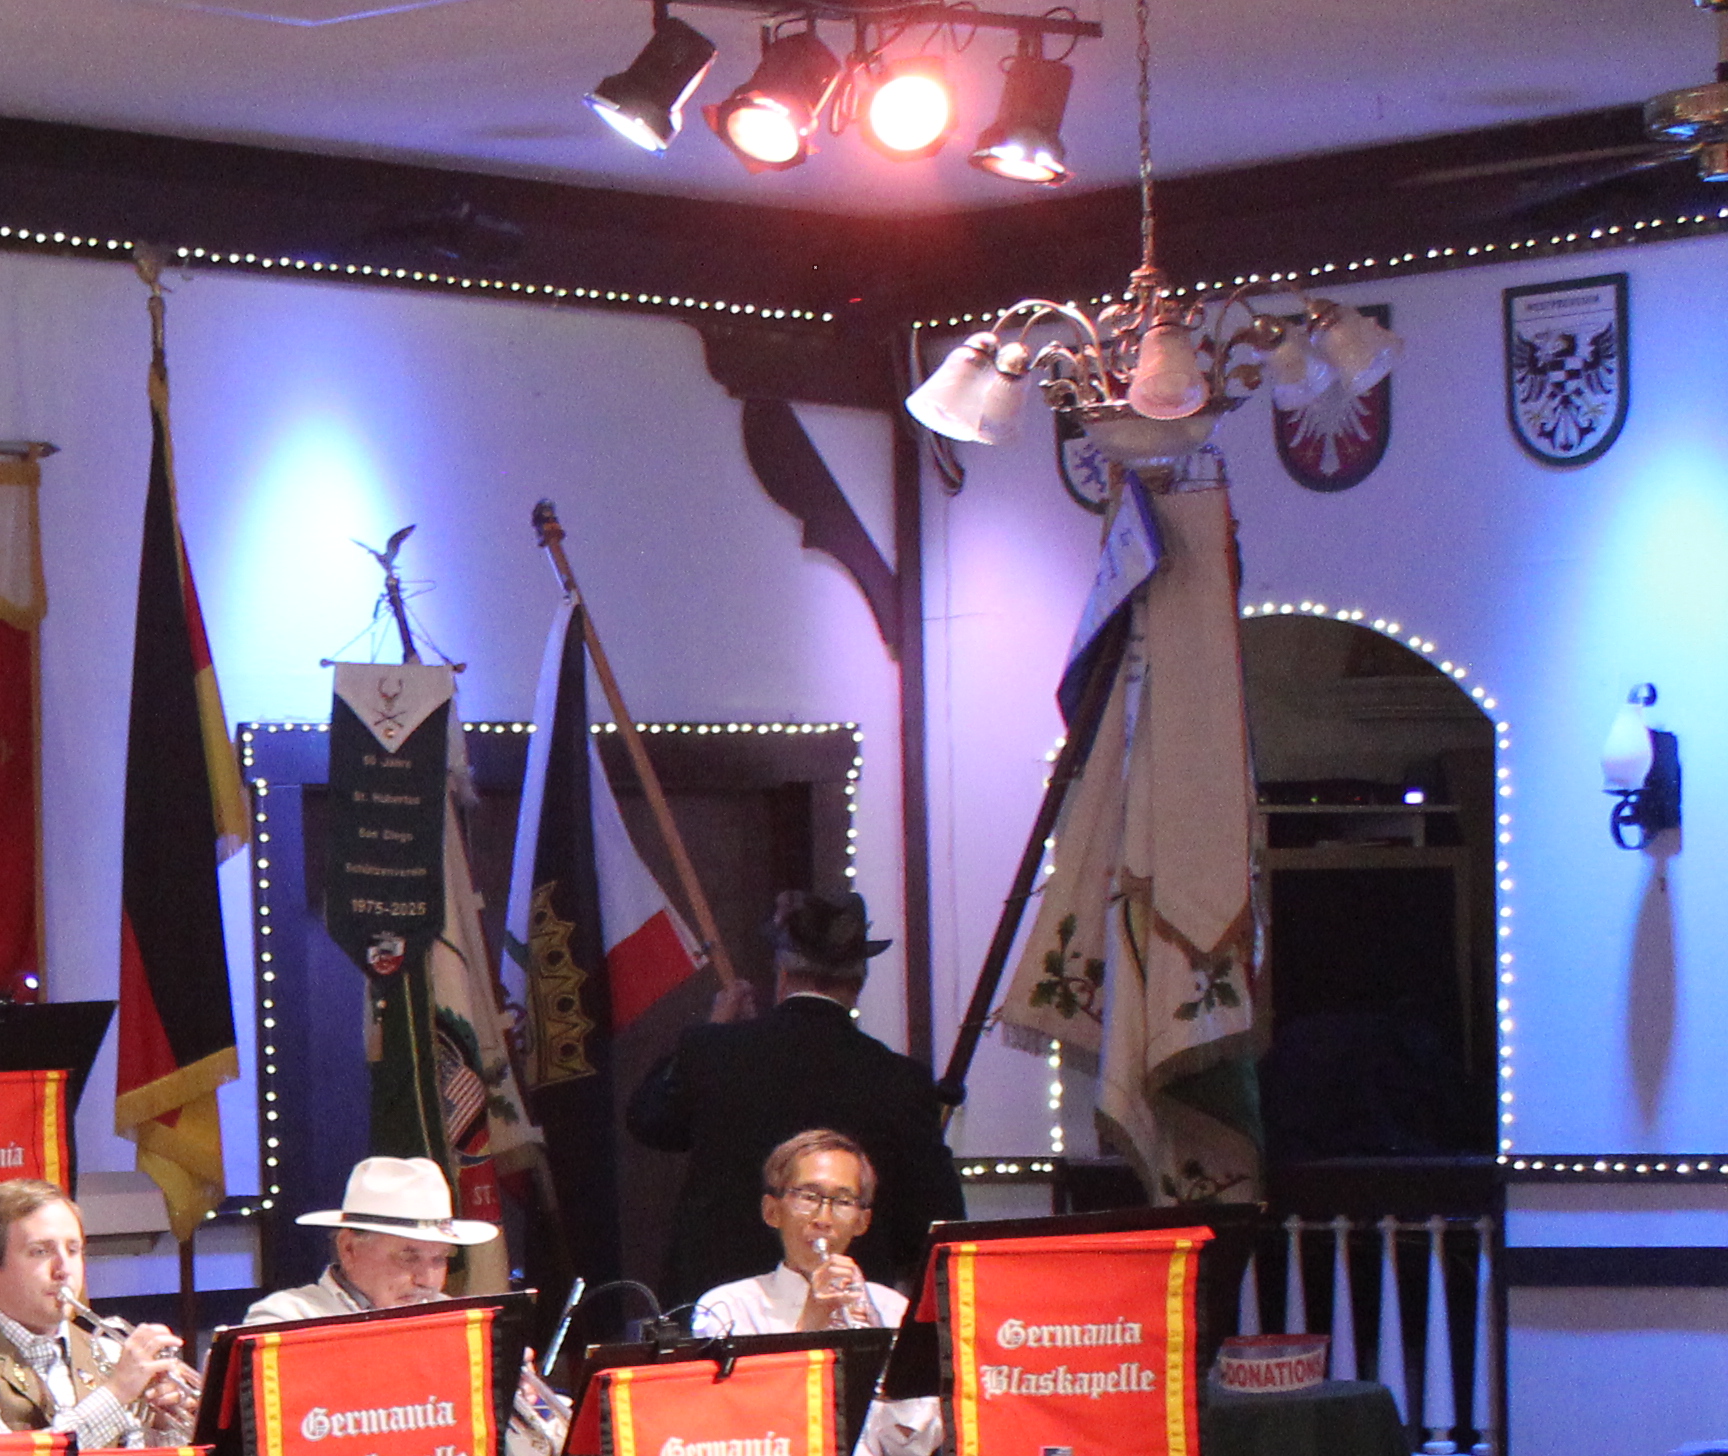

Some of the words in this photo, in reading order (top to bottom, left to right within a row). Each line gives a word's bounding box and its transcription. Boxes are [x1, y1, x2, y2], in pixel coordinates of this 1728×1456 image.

[997, 1316, 1142, 1349] Germania
[980, 1362, 1156, 1400] Blaskapelle
[300, 1395, 457, 1442] Germania
